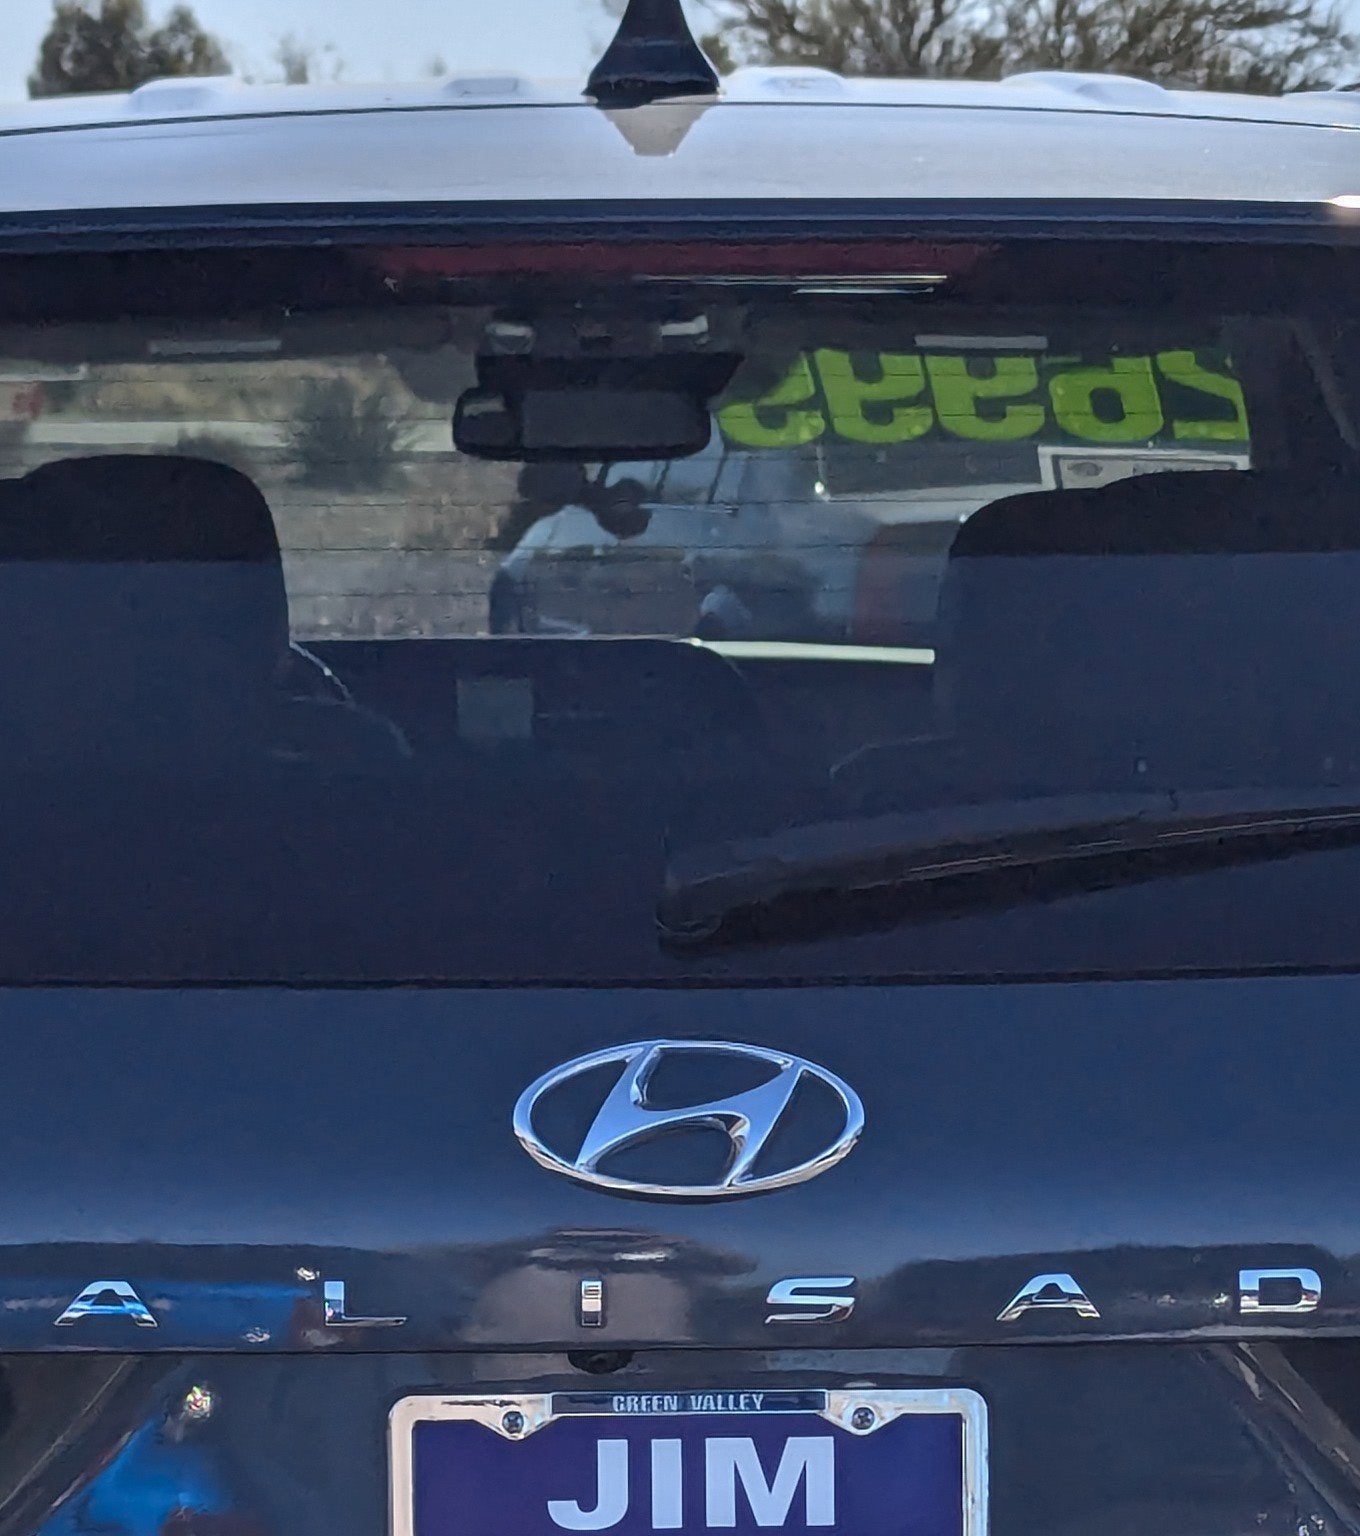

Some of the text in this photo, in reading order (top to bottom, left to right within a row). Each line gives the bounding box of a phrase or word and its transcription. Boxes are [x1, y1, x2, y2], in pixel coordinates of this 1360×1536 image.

[612, 1392, 765, 1413] GREEN VALLEY
[546, 1435, 836, 1531] JIM
